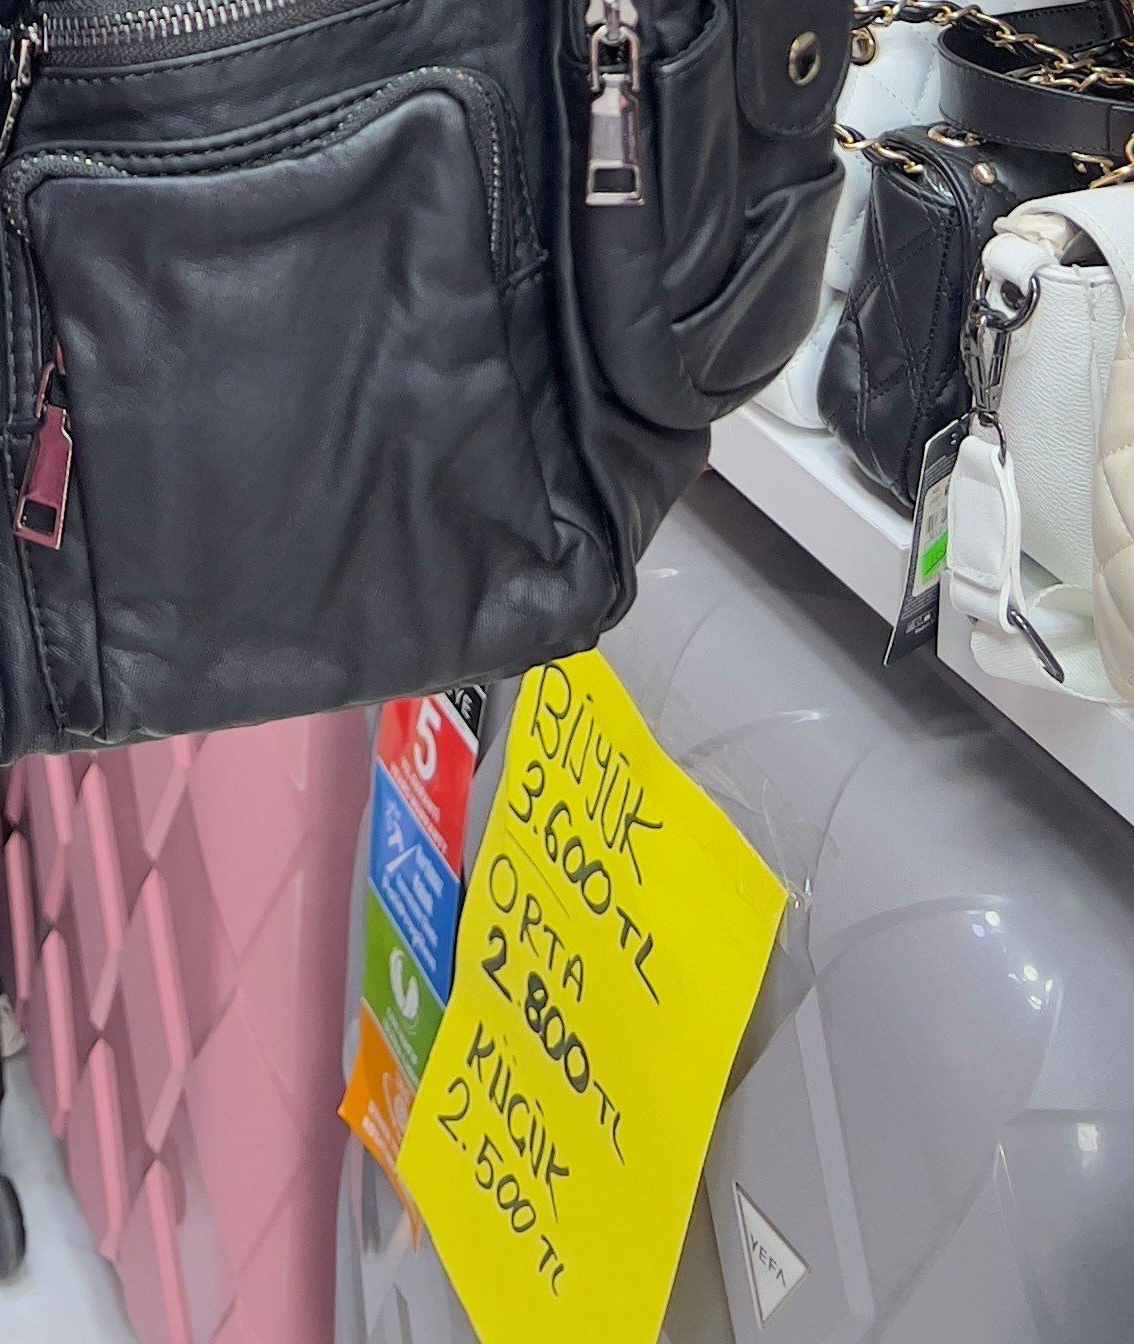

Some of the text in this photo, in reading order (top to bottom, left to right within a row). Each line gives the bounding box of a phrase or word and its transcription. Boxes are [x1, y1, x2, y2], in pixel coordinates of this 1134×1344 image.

[413, 697, 442, 781] 5
[532, 663, 662, 885] BÜYÜK
[489, 853, 584, 1002] ORTA
